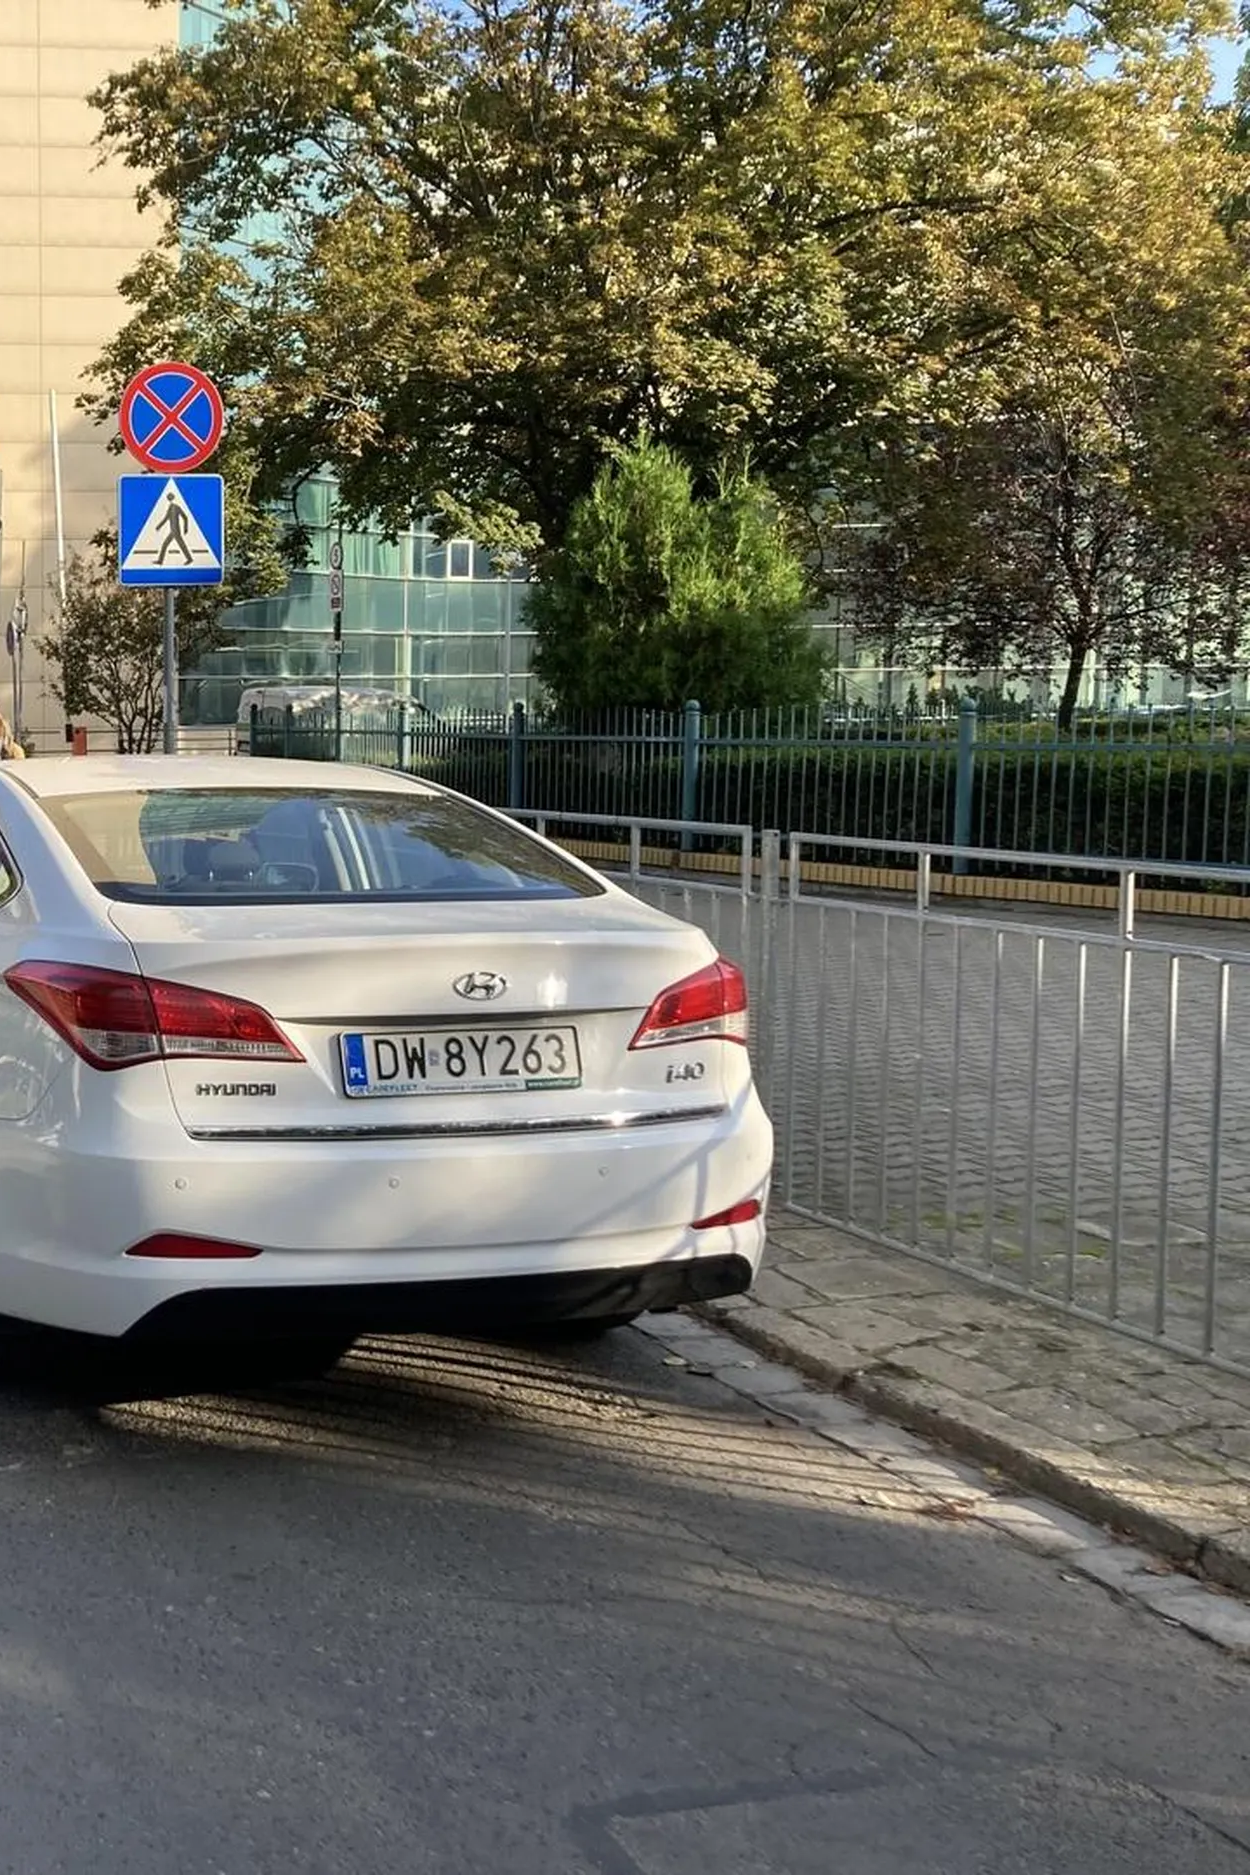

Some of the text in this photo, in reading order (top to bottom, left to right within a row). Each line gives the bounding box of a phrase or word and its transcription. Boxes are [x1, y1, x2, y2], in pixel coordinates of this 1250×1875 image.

[374, 1033, 567, 1080] DW 8Y263
[350, 1066, 365, 1079] PL
[666, 1062, 705, 1084] i40
[195, 1083, 276, 1097] HYUNDAI
